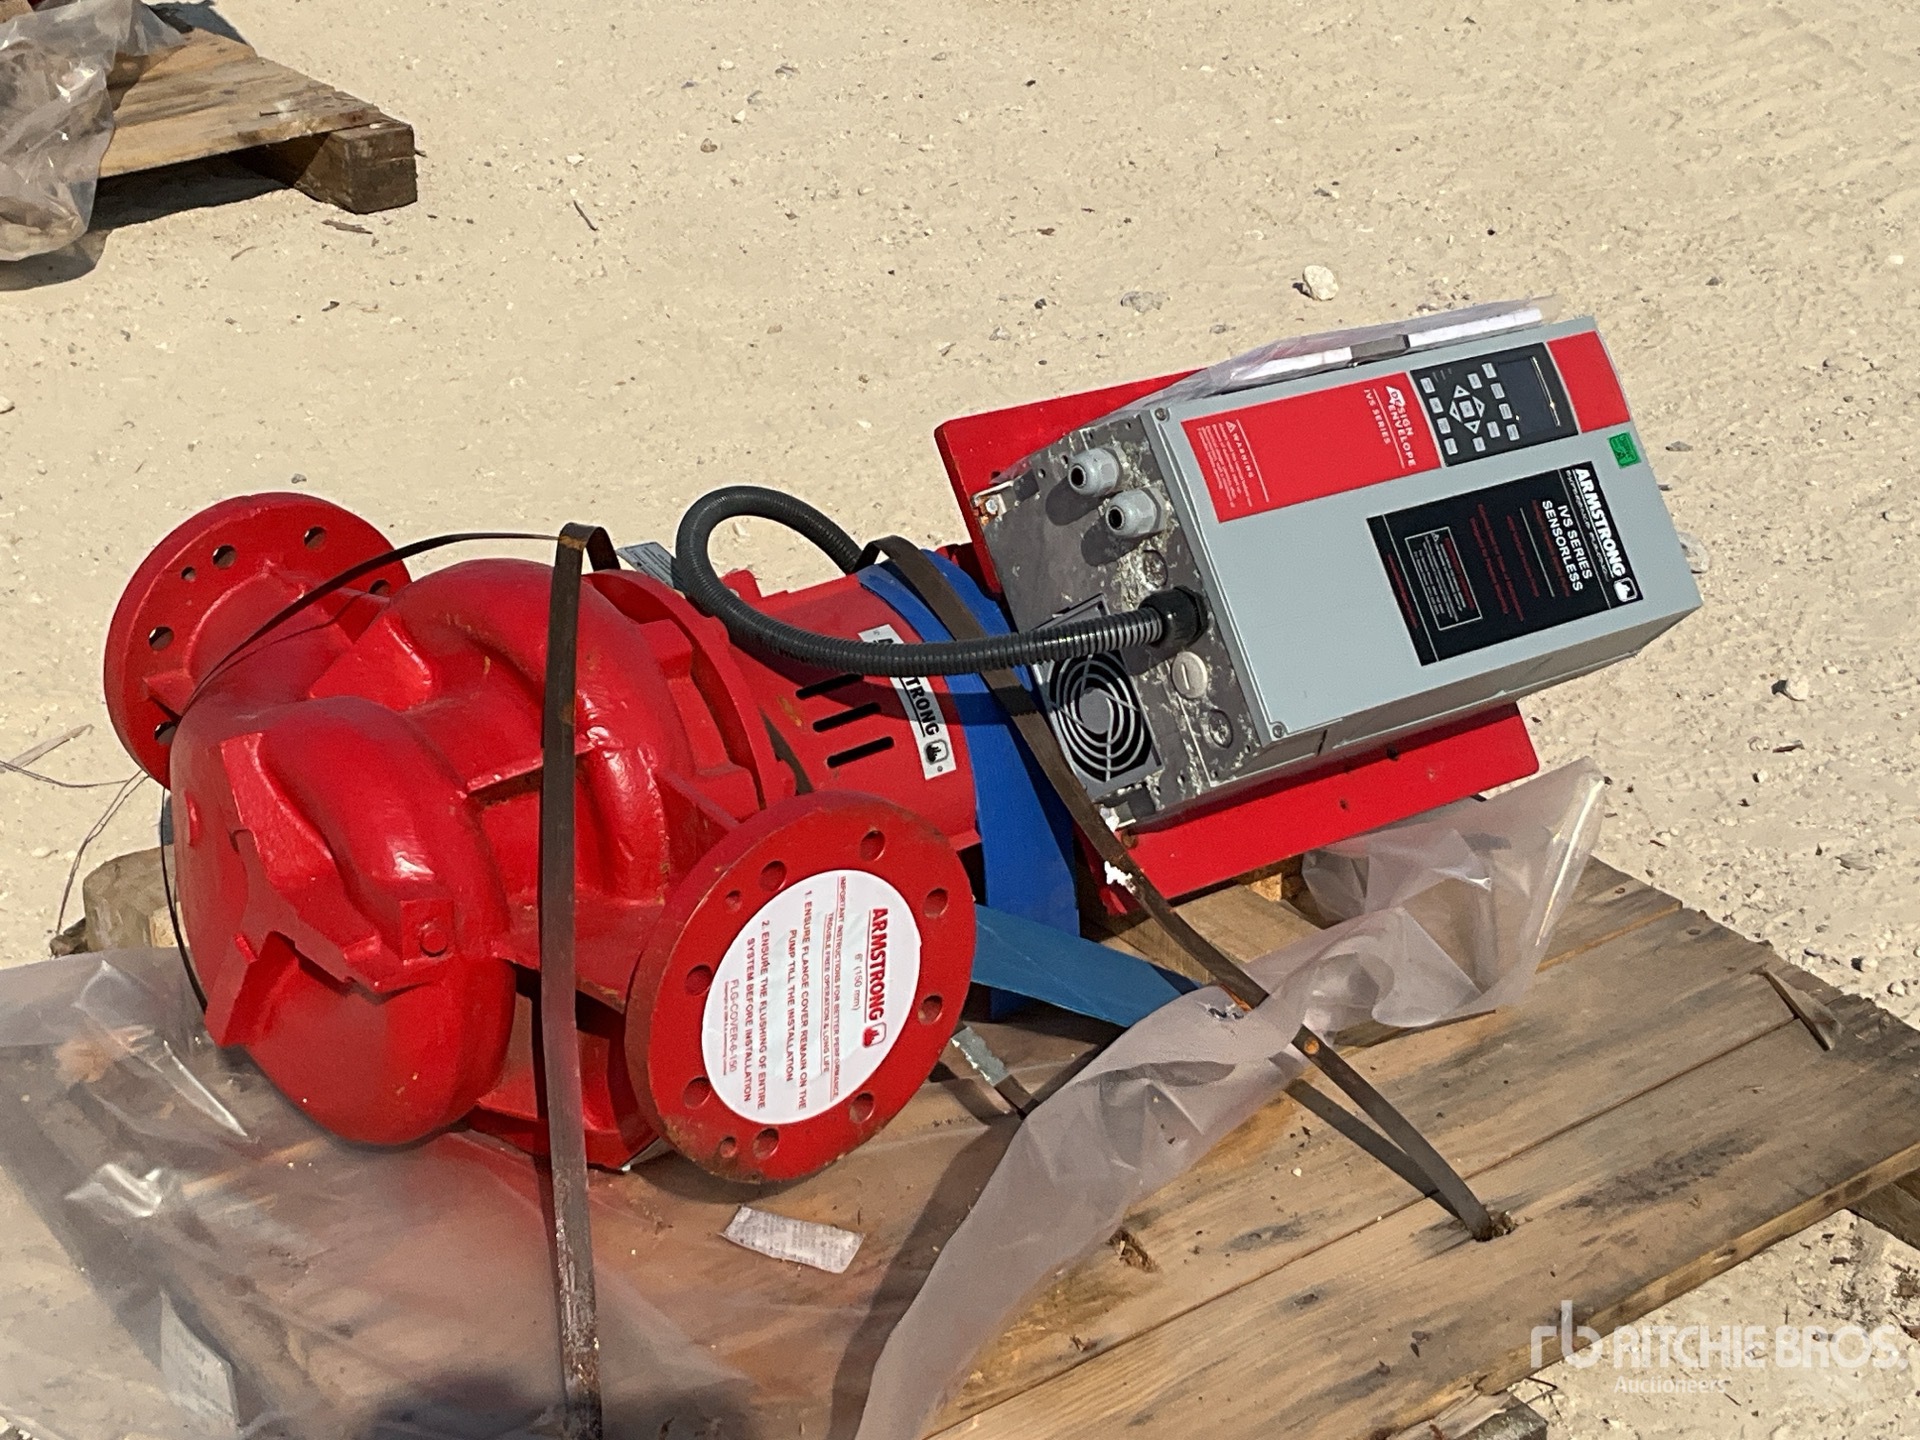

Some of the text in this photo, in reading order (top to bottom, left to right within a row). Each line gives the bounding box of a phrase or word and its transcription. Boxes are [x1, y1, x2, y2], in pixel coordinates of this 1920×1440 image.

[1364, 389, 1392, 445] IVS SERIES
[1388, 405, 1416, 466] ENVELOPE
[1232, 433, 1255, 479] WARNING
[1557, 505, 1593, 580] IVS SERIES
[1575, 466, 1627, 578] ARMSTRONG
[1541, 499, 1584, 592] SENSORLESS
[789, 929, 797, 958] PUMP
[802, 901, 812, 943] ENSURE
[825, 912, 834, 950] TROUBLE
[760, 931, 770, 974] ENSURE
[787, 960, 796, 983] TILL
[801, 945, 809, 988] FLANGE
[835, 925, 844, 983] INSTRUCTIONS
[869, 908, 888, 1022] ARMSTRONG
[760, 977, 768, 998] THE
[823, 974, 831, 1022] OPERATION
[854, 967, 863, 987] (150
[744, 938, 755, 1102] SYSTEM BEFORE INSTALLATION
[801, 990, 809, 1027] COVER
[852, 990, 860, 1010] mm)
[759, 1000, 767, 1053] FLUSHING
[786, 1008, 794, 1081] INSTALLATION
[759, 1056, 767, 1069] OF
[800, 1030, 808, 1070] REMAIN
[757, 1072, 766, 1110] ENTIRE
[799, 1073, 807, 1087] ON
[799, 1088, 807, 1110] THE
